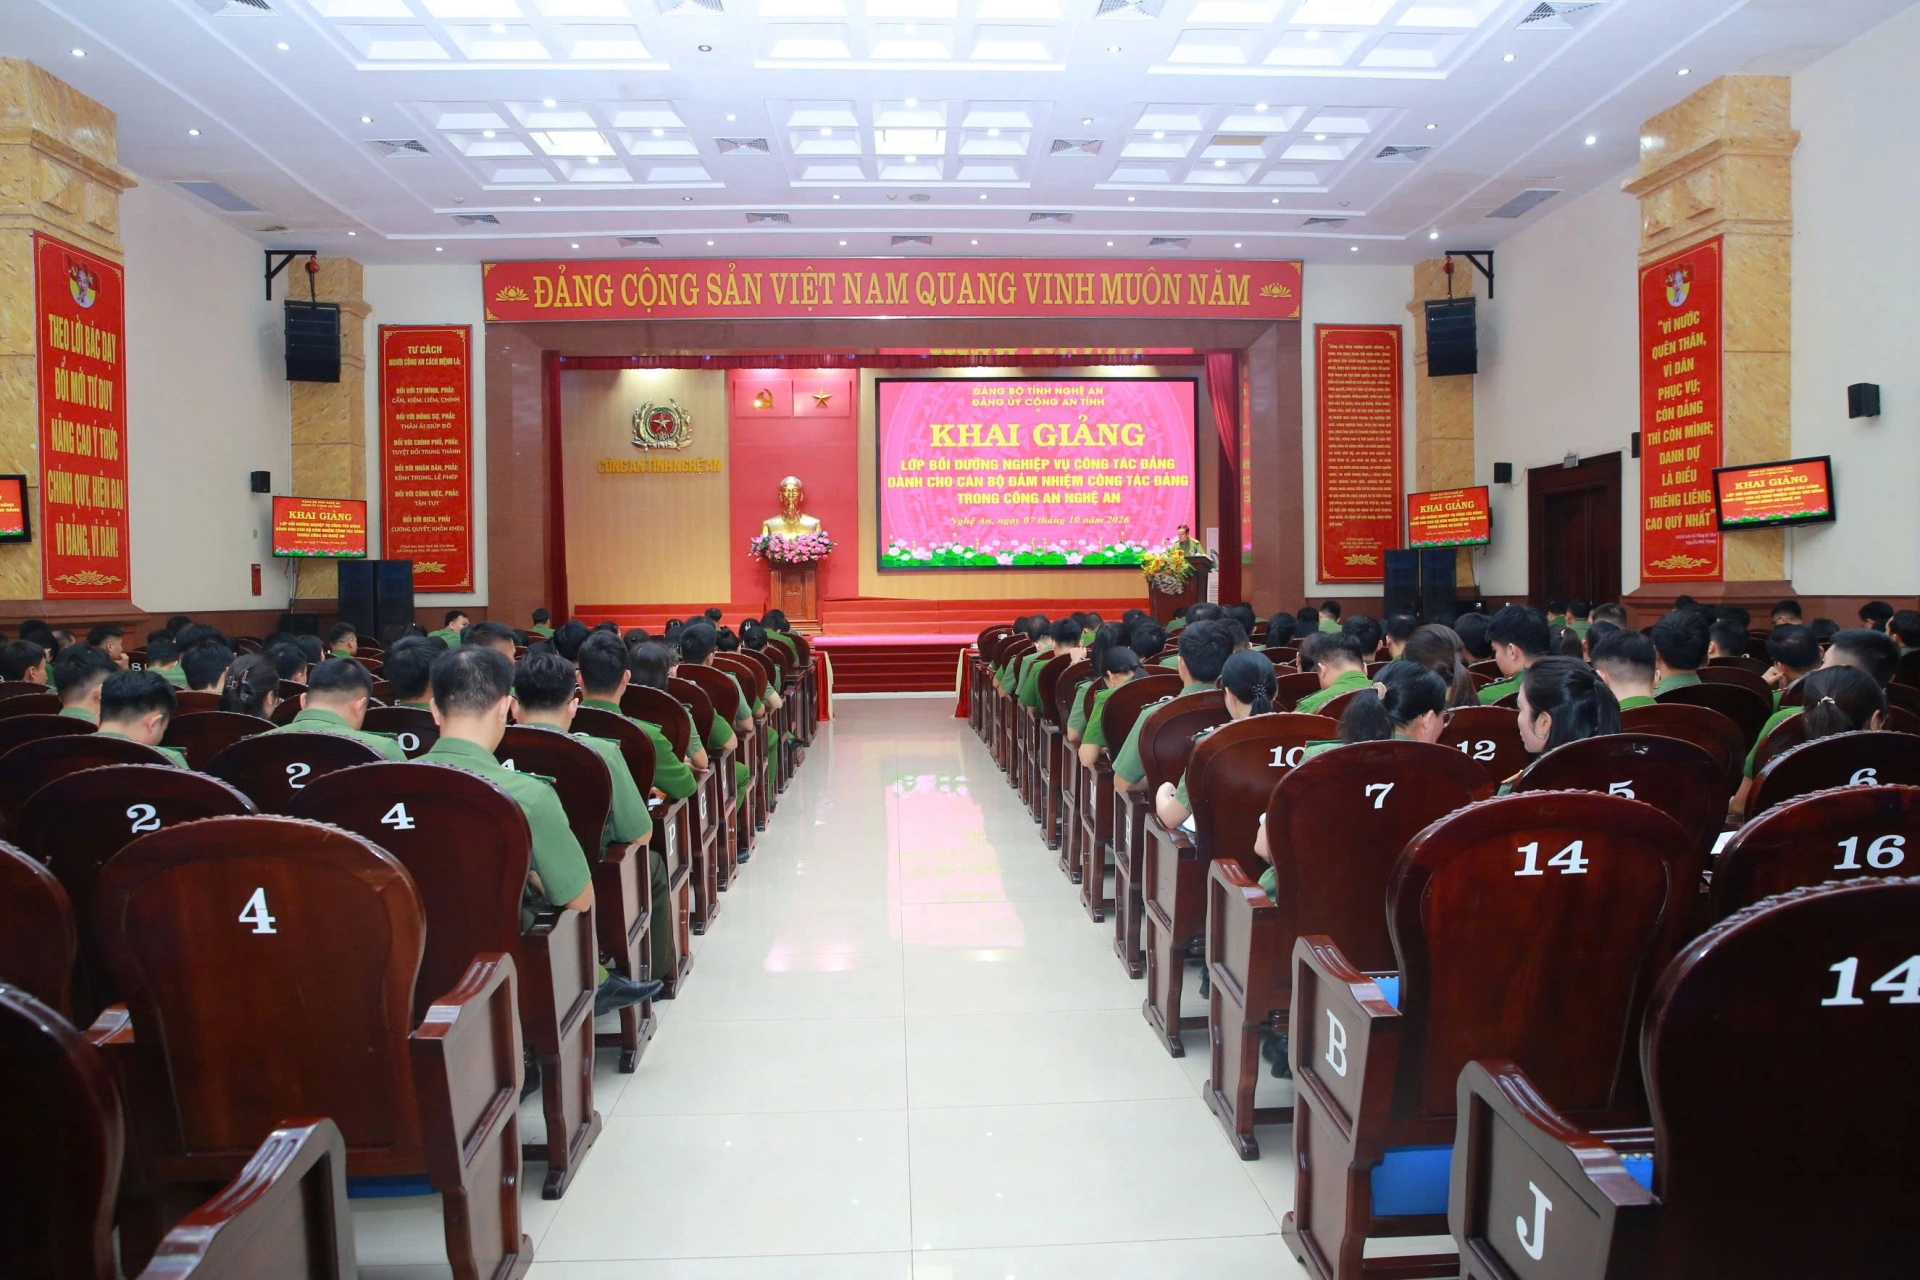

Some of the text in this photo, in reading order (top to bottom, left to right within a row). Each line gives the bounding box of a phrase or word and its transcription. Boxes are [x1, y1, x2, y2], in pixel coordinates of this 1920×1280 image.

[533, 262, 1251, 313] ĐẢNG CỘNG SẢN VIỆT NAM QUANG VINH MUÔN NĂM
[1674, 310, 1700, 331] NƯỚC
[48, 313, 116, 370] THEO LỜI BÁC DẠY
[407, 344, 442, 354] TƯ CÁCH
[1652, 332, 1706, 360] QUÊN THÂN,
[1663, 357, 1695, 377] VÌ DÂN
[54, 356, 113, 412] ĐỔI MỚI TƯ DUY
[973, 385, 1103, 397] ĐẢNG BỘ TỈNH NGHỆ AN
[1658, 379, 1700, 401] PHỤC VỤ;
[971, 396, 1105, 407] ĐẢNG ỦY CÔNG AN TỈNH
[1656, 399, 1703, 423] CÒN ĐẢNG
[51, 412, 119, 461] NÂNG CAO Ý THỨC
[930, 414, 1146, 447] KHAI GIẢNG
[1647, 421, 1713, 446] THÌ CÒN MÌNH;
[598, 456, 627, 473] CÔNG
[629, 460, 645, 473] AN
[674, 456, 703, 475] NGHỆ
[706, 460, 721, 472] AN
[900, 457, 925, 471] LỚP
[954, 457, 999, 470] DƯỠNG
[1002, 456, 1050, 472] NGHIỆP
[1053, 458, 1070, 472] VỤ
[1074, 456, 1109, 470] CÔNG
[1113, 456, 1137, 470] TÁC
[1140, 454, 1175, 470] ĐẢNG
[1660, 444, 1701, 465] DANH DỰ
[887, 472, 1189, 490] DÀNH CHO CÁN BỘ ĐẢM NHIỆM CÔNG TÁC ĐẢNG
[1661, 470, 1673, 486] LÀ
[1735, 475, 1808, 490] KHAI GIẢNG
[47, 464, 124, 516] CHÍNH QUY, HIỆN ĐẠI
[957, 490, 1121, 505] TRONG CÔNG AN NGHỆ AN
[1649, 492, 1681, 509] THIÊNG
[1683, 488, 1711, 505] LIÊNG
[288, 510, 352, 521] KHAI GIẢNG
[1420, 499, 1475, 513] KHAI GIẢNG
[997, 516, 1020, 526] ngày
[1037, 516, 1065, 526] tháng
[1069, 516, 1080, 524] 10
[1082, 516, 1104, 524] năm
[1645, 517, 1662, 531] CAO
[1665, 512, 1683, 530] QUÝ
[56, 512, 119, 560] VÌ ĐẢNG, VÌ DÂN!
[1268, 746, 1306, 768] 10
[1456, 740, 1496, 761] 12
[286, 763, 311, 788] 2
[1849, 768, 1878, 786] 6
[1365, 782, 1395, 809] 7
[1608, 780, 1635, 800] 5
[126, 803, 161, 834] 2
[381, 803, 415, 830] 4
[668, 823, 676, 856] P
[1514, 840, 1589, 876] 14
[1833, 834, 1906, 870] 16
[238, 887, 277, 934] 4
[1820, 955, 1920, 1007] 14
[1325, 1009, 1347, 1078] B
[1516, 1180, 1553, 1261] J
